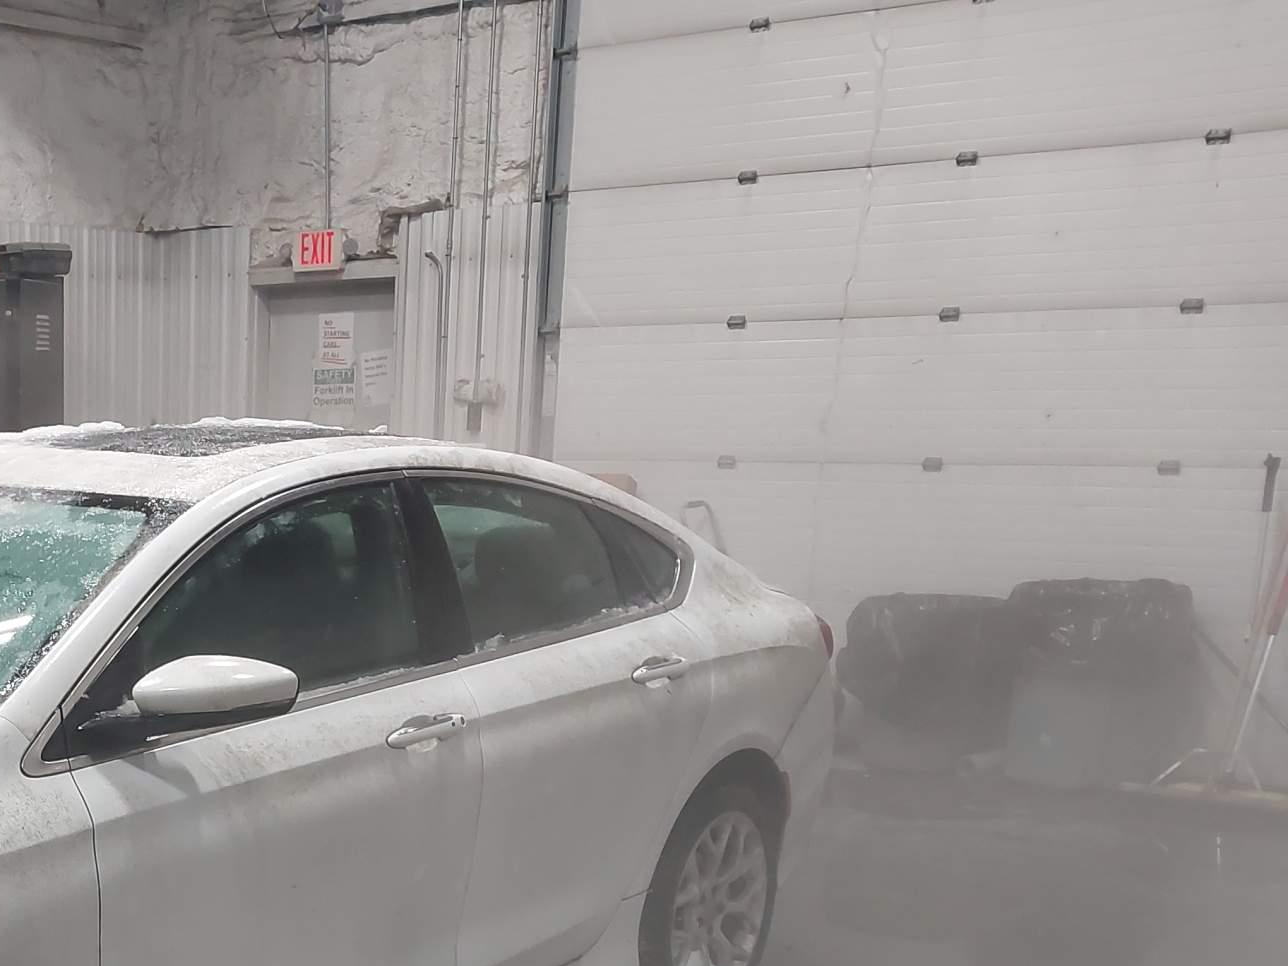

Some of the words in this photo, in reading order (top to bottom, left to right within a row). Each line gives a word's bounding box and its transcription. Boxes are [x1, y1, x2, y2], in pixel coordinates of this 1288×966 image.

[300, 231, 335, 265] EXIT
[316, 369, 353, 380] SAFETY
[314, 385, 344, 395] Forklift
[313, 396, 354, 408] Operation
